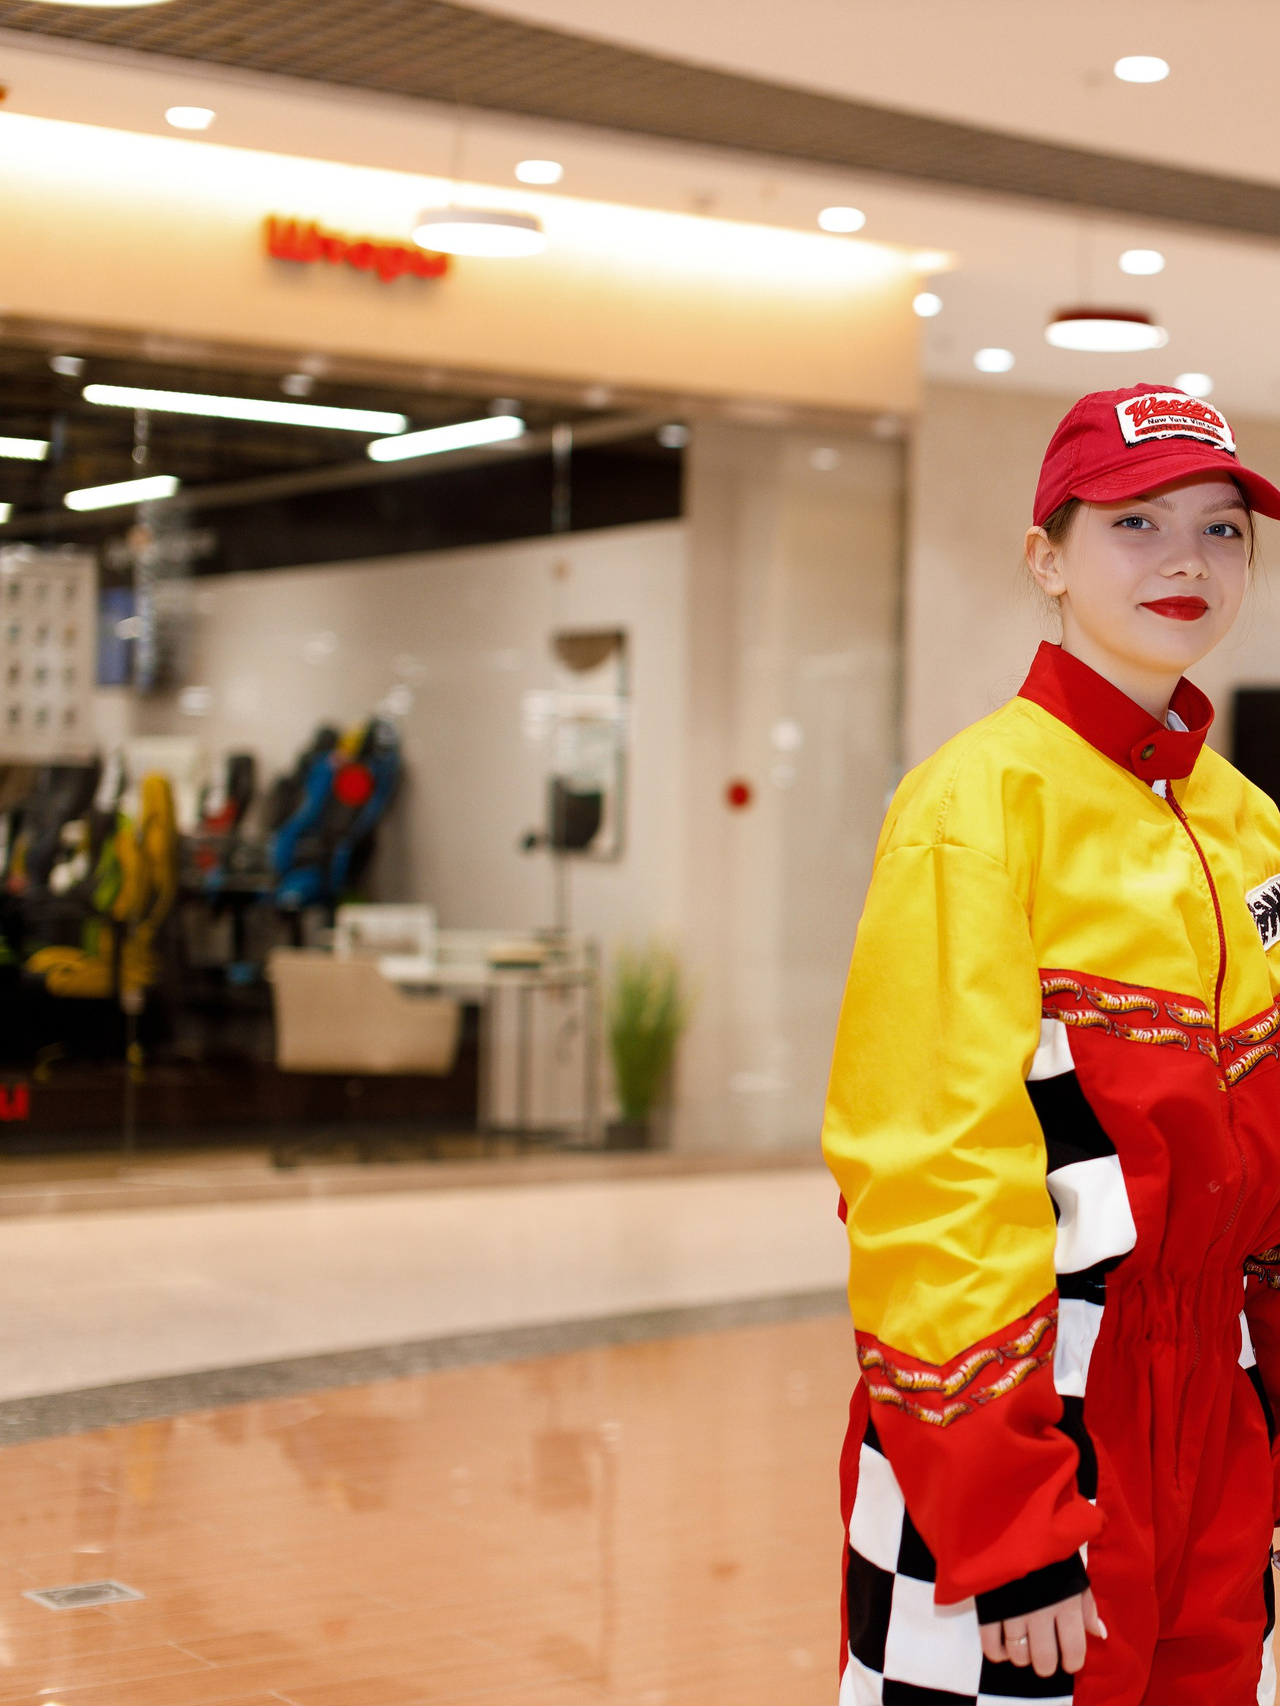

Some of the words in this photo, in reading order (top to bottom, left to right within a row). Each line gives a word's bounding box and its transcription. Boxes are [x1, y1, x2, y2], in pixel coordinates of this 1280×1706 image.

[1125, 396, 1224, 428] Western
[1147, 417, 1167, 426] New
[1168, 415, 1188, 424] York
